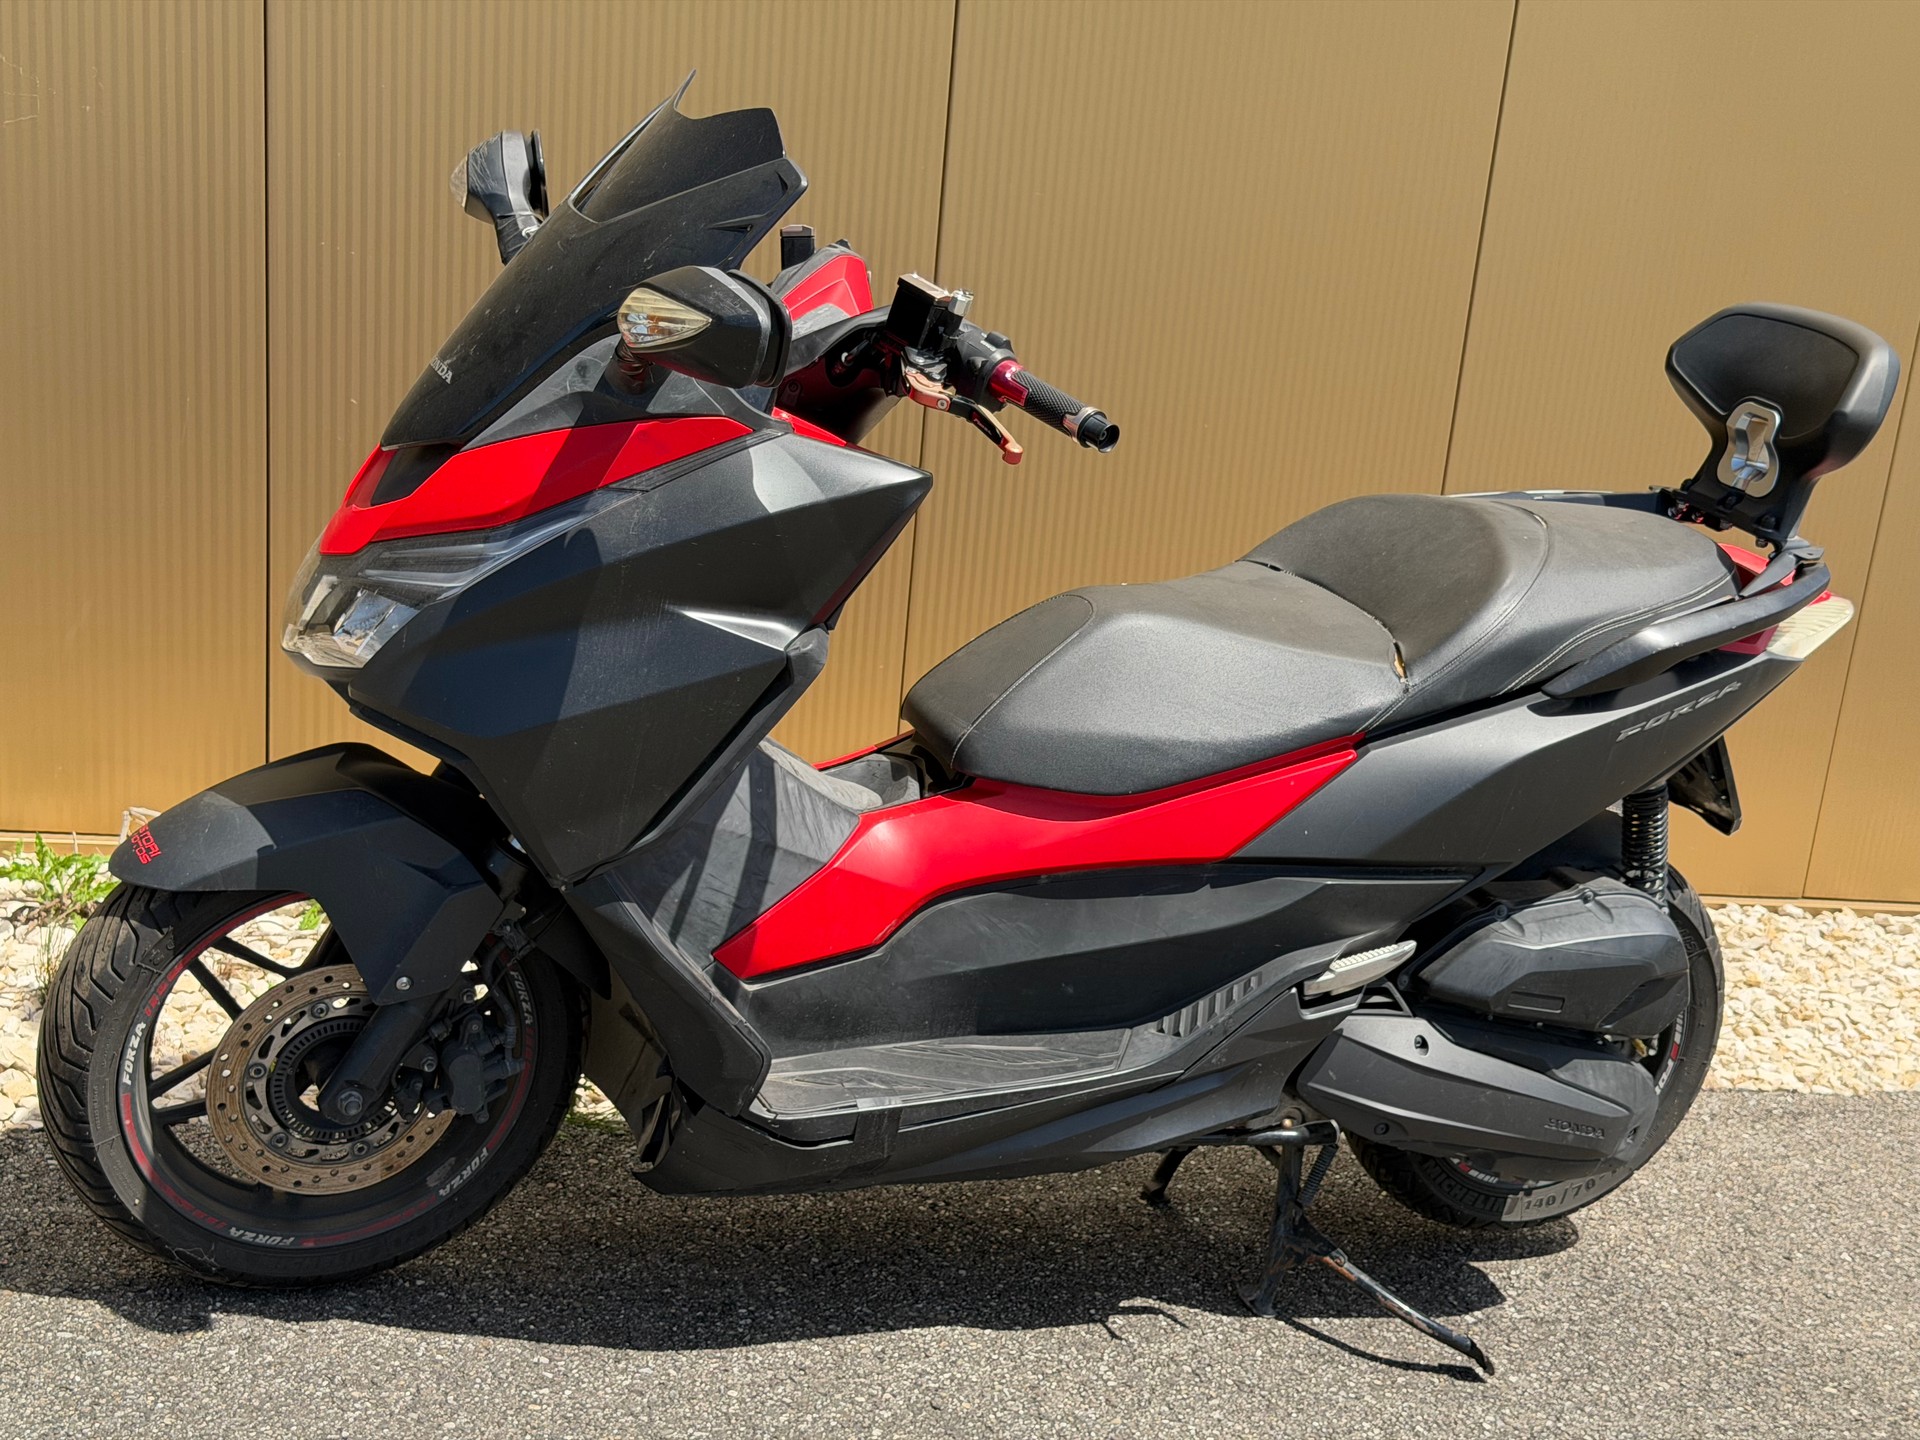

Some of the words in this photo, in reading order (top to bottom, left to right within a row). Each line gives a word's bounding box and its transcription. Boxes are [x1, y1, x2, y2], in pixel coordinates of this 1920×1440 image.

[1616, 681, 1742, 742] FORZA
[510, 971, 534, 1025] FORZA
[122, 1021, 147, 1086] FORZA
[1543, 1118, 1606, 1140] HONDA
[438, 1146, 489, 1197] FORZA
[229, 1226, 296, 1247] FORZA
